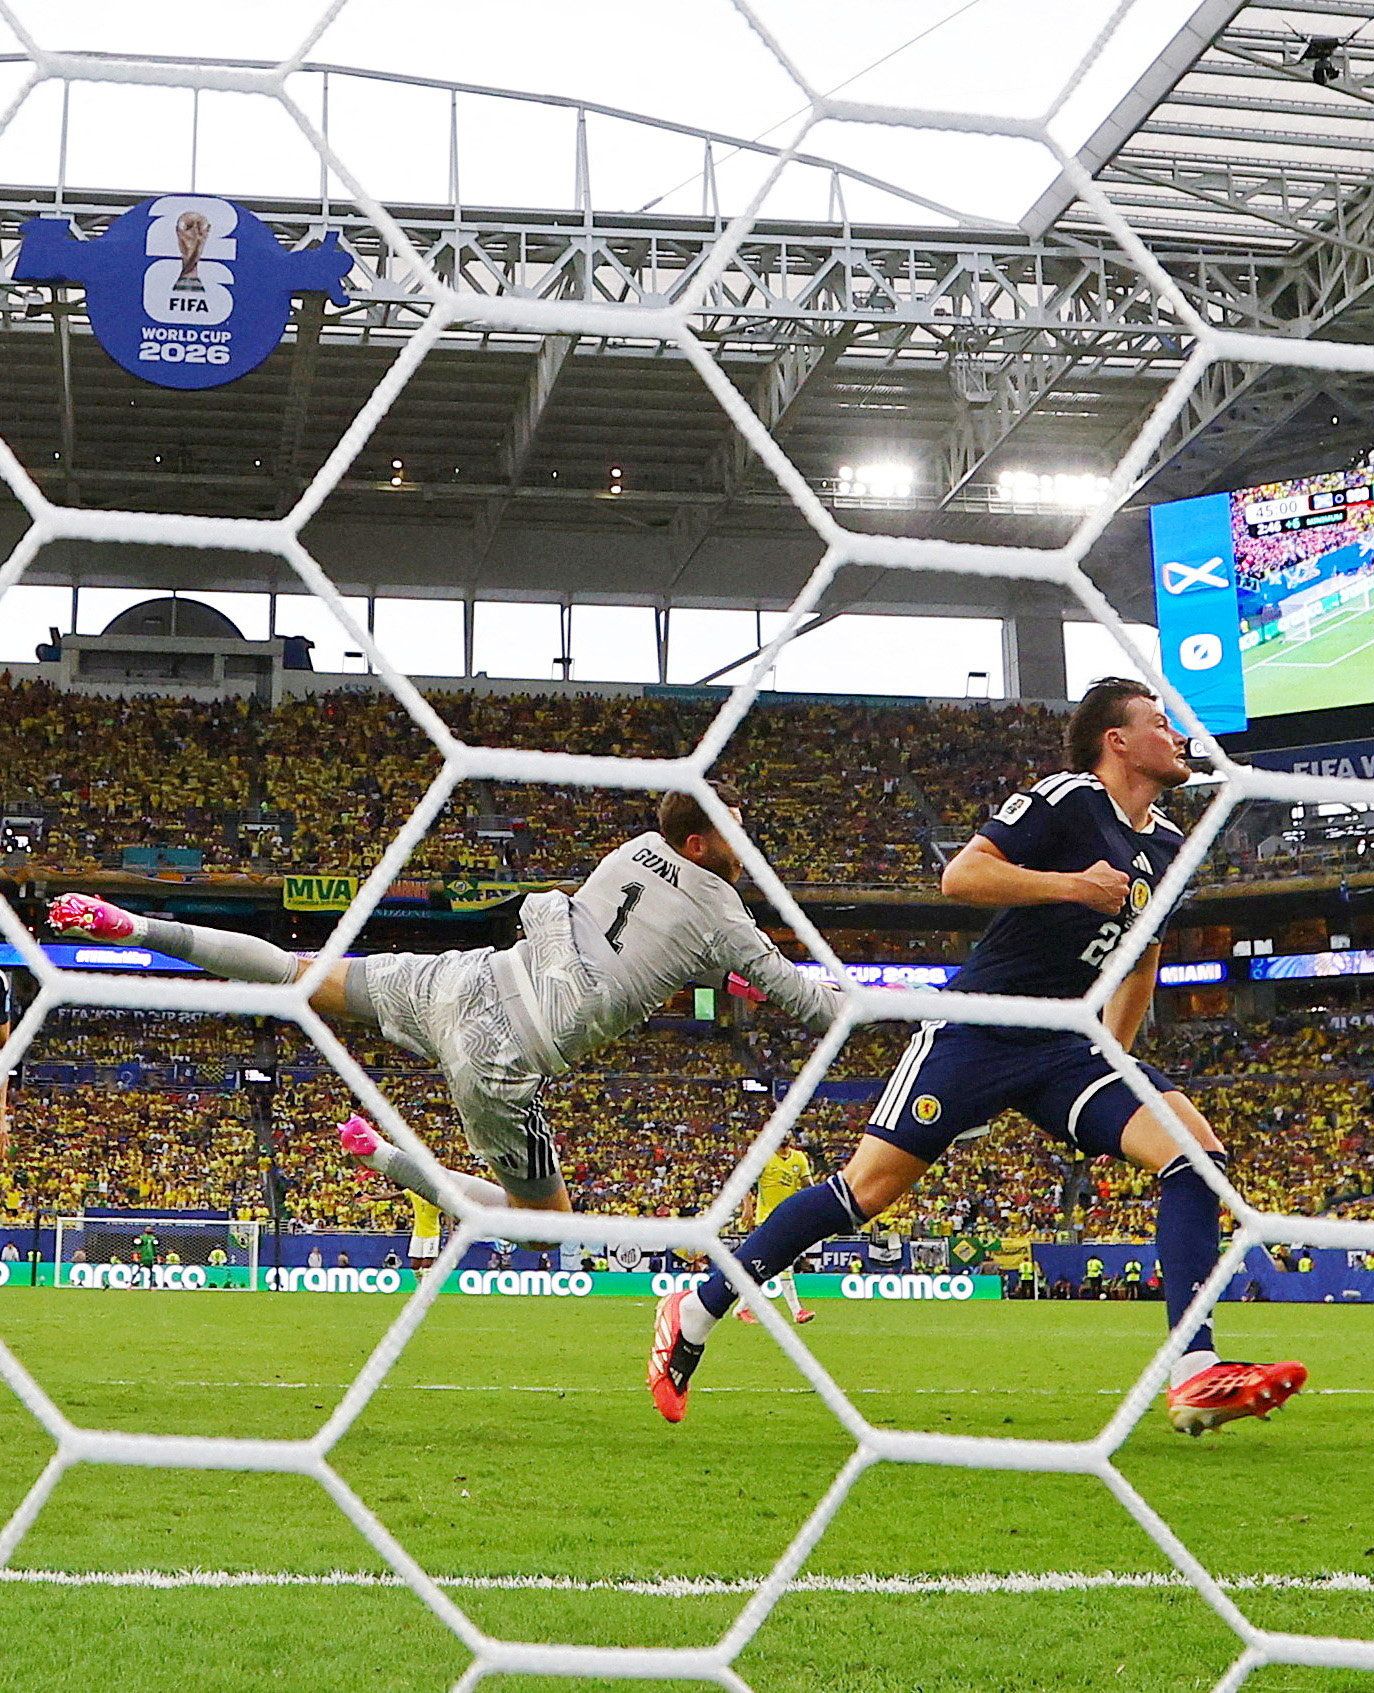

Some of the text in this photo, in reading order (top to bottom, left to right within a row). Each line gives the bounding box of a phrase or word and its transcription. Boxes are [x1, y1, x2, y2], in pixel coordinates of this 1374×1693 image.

[169, 298, 209, 312] FIFA
[142, 327, 232, 343] WORLD CUP
[139, 341, 231, 365] 2026
[1256, 501, 1297, 517] 45:00
[1179, 634, 1223, 671] 0
[1293, 758, 1358, 779] FIFA
[632, 847, 681, 888] GUNN
[286, 877, 351, 903] MVA
[604, 881, 646, 955] 1
[845, 966, 882, 982] CUP
[883, 967, 948, 984] 2026
[1161, 963, 1222, 983] MIAMI
[70, 1263, 206, 1290] aramco
[265, 1267, 401, 1294] aramco
[459, 1270, 593, 1296] aramco
[841, 1274, 974, 1300] aramco
